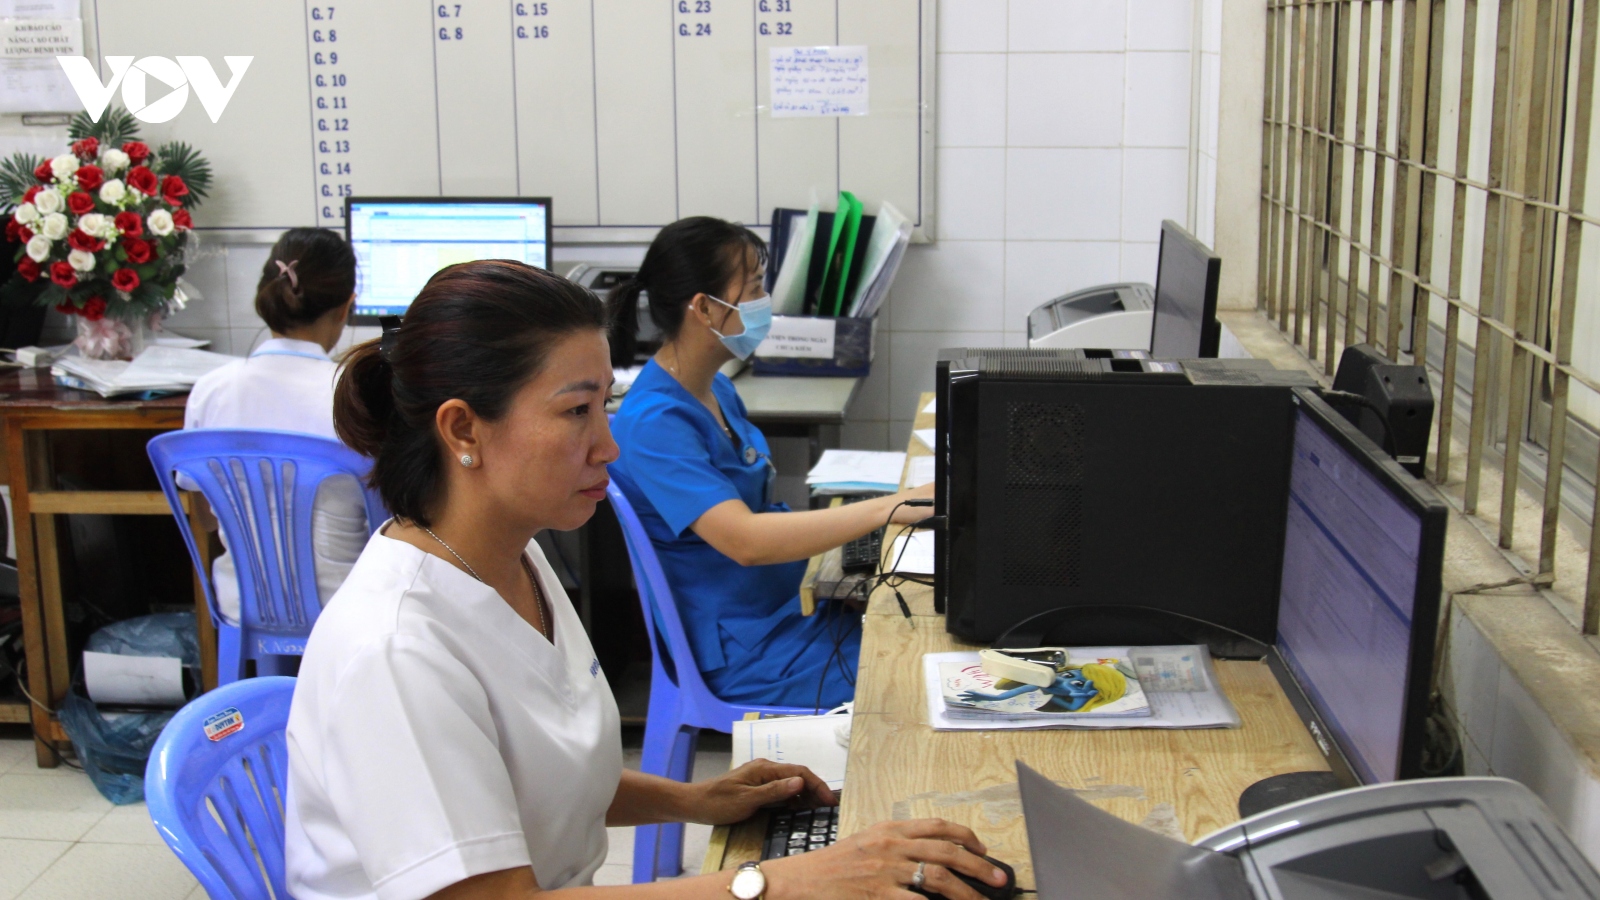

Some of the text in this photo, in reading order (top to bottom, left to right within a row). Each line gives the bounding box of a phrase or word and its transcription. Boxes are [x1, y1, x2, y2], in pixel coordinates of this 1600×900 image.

[438, 5, 461, 17] G. 7
[516, 3, 547, 16] G. 15
[679, 0, 711, 13] G. 23
[759, 0, 791, 12] G. 31
[312, 7, 335, 20] G. 7
[439, 27, 463, 40] G. 8
[517, 26, 548, 38] G. 16
[679, 23, 711, 36] G. 24
[759, 22, 792, 35] G. 32
[313, 30, 336, 42] G. 8
[314, 52, 338, 65] G. 9
[316, 74, 346, 87] G. 10
[317, 97, 346, 109] G. 11
[318, 118, 348, 131] G. 12
[319, 140, 350, 153] G. 13
[320, 163, 351, 175] G. 14
[321, 184, 352, 197] G. 15
[322, 206, 334, 218] G.
